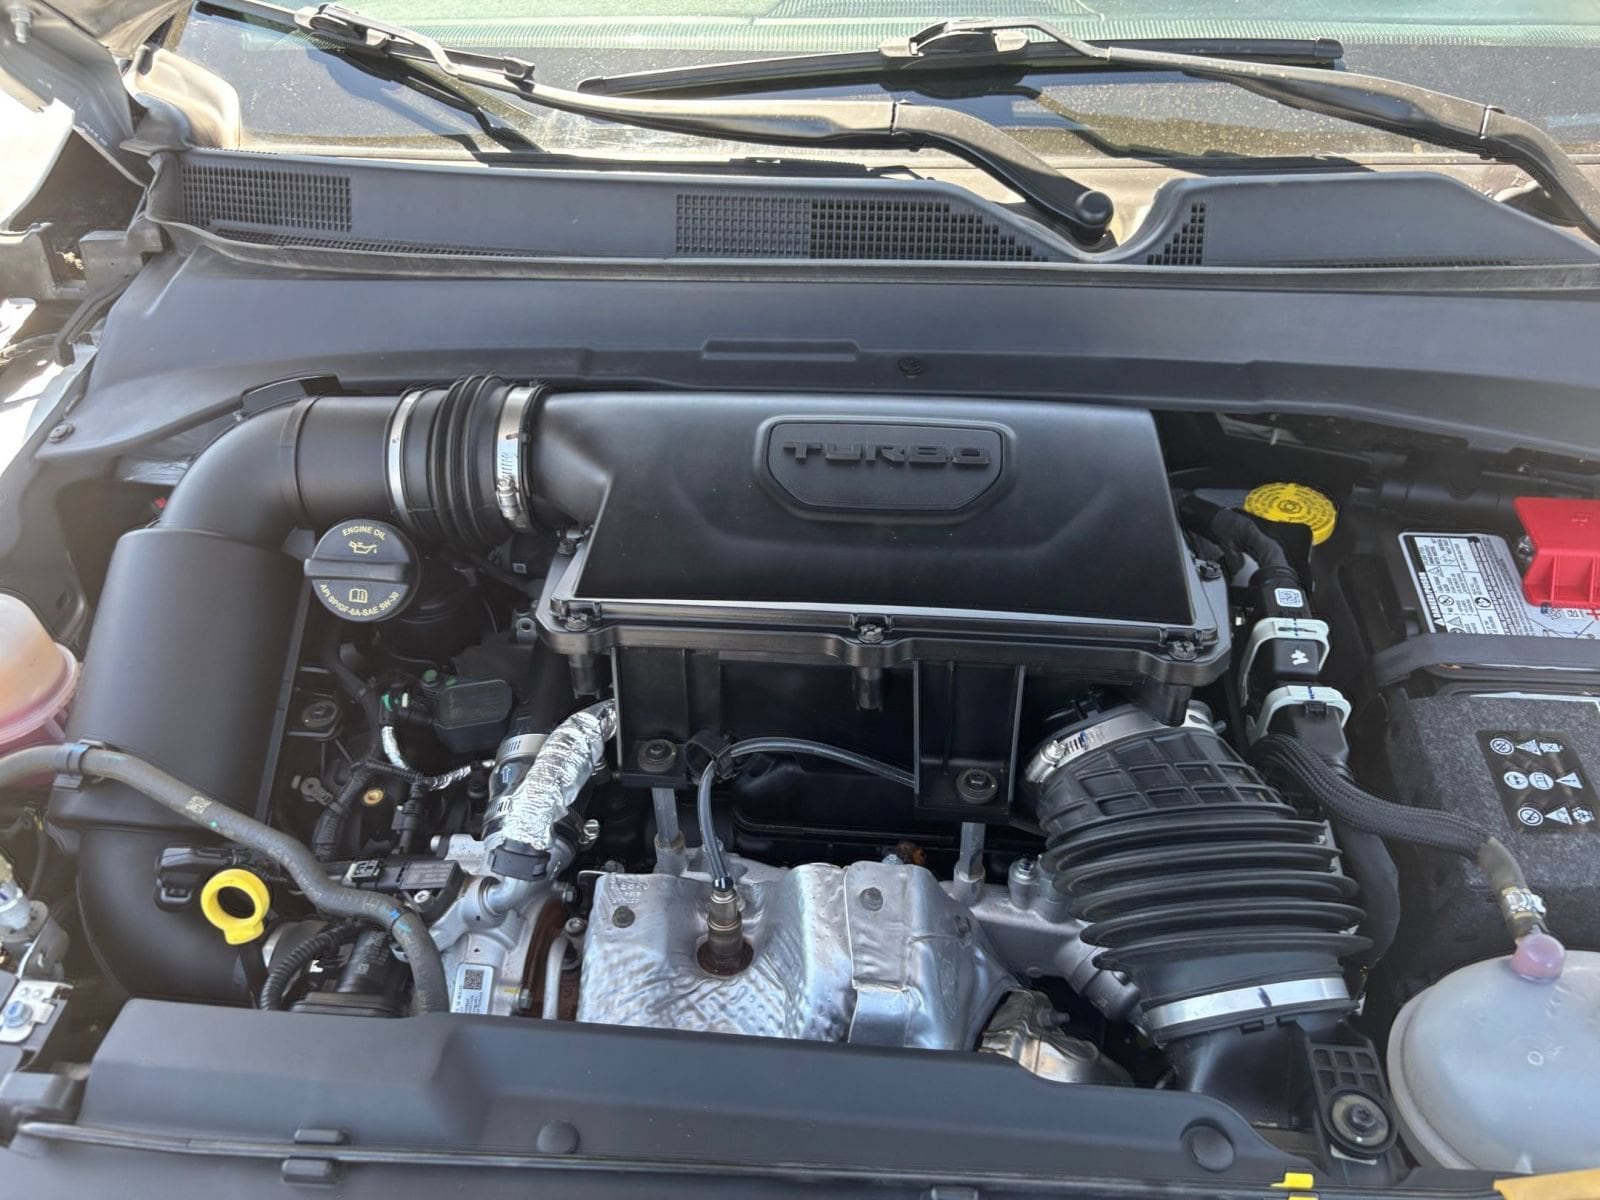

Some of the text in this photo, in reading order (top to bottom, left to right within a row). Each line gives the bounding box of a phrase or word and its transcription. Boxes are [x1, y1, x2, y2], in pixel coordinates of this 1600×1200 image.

[783, 441, 991, 464] TURBO
[342, 526, 387, 540] ENGINE OIL
[320, 584, 330, 597] API
[379, 591, 399, 611] 5W-30
